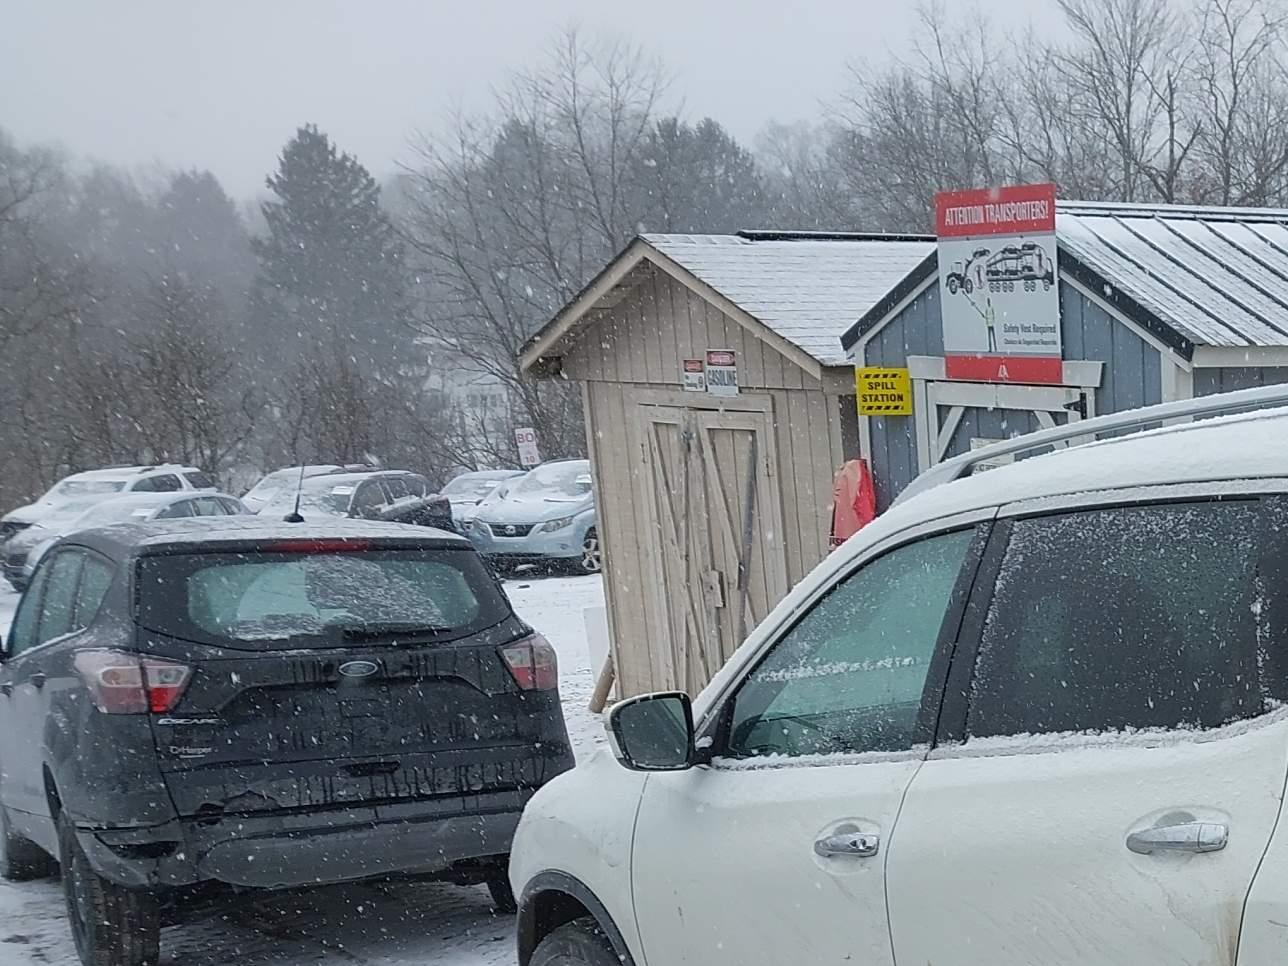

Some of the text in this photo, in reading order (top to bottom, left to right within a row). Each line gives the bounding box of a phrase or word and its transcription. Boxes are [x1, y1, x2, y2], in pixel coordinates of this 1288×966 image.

[945, 200, 1049, 226] ATTENTION TRANSPORTERS!
[707, 369, 737, 386] GASOLINE
[868, 381, 896, 390] SPILL
[862, 393, 904, 402] STATION
